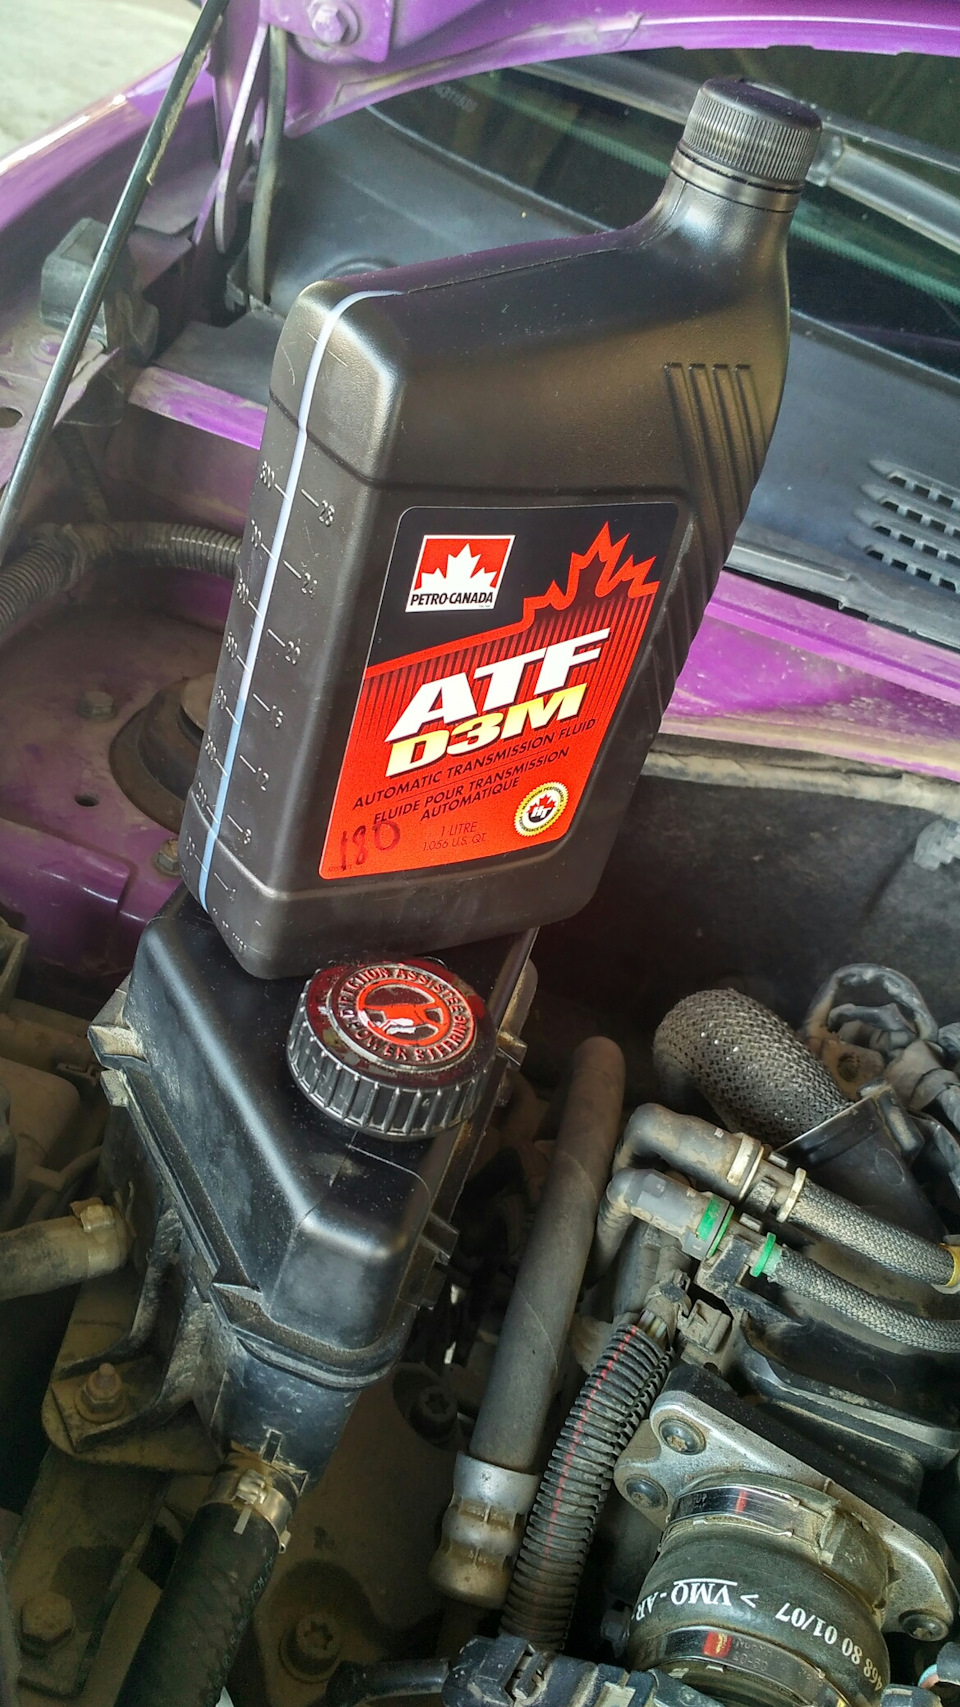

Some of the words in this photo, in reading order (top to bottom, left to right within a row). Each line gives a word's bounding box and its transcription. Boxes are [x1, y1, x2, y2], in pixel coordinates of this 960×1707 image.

[384, 627, 611, 742] ATF
[385, 682, 588, 778] D3M
[352, 773, 443, 810] AUTOMATIC
[446, 735, 553, 777] TRANSMISSION
[557, 718, 597, 741] FLUID
[373, 799, 420, 825] FLUIDE
[424, 784, 464, 807] POUR
[468, 747, 570, 790] TRANSMISSION
[419, 777, 521, 821] AUTOMATIQUE
[423, 840, 449, 852] 1.056
[452, 836, 468, 847] U.S.
[441, 826, 446, 837] 1
[449, 821, 478, 836] LITRE
[346, 1020, 408, 1062] POWER
[775, 1602, 838, 1645] 01/07
[842, 1636, 863, 1665] 80
